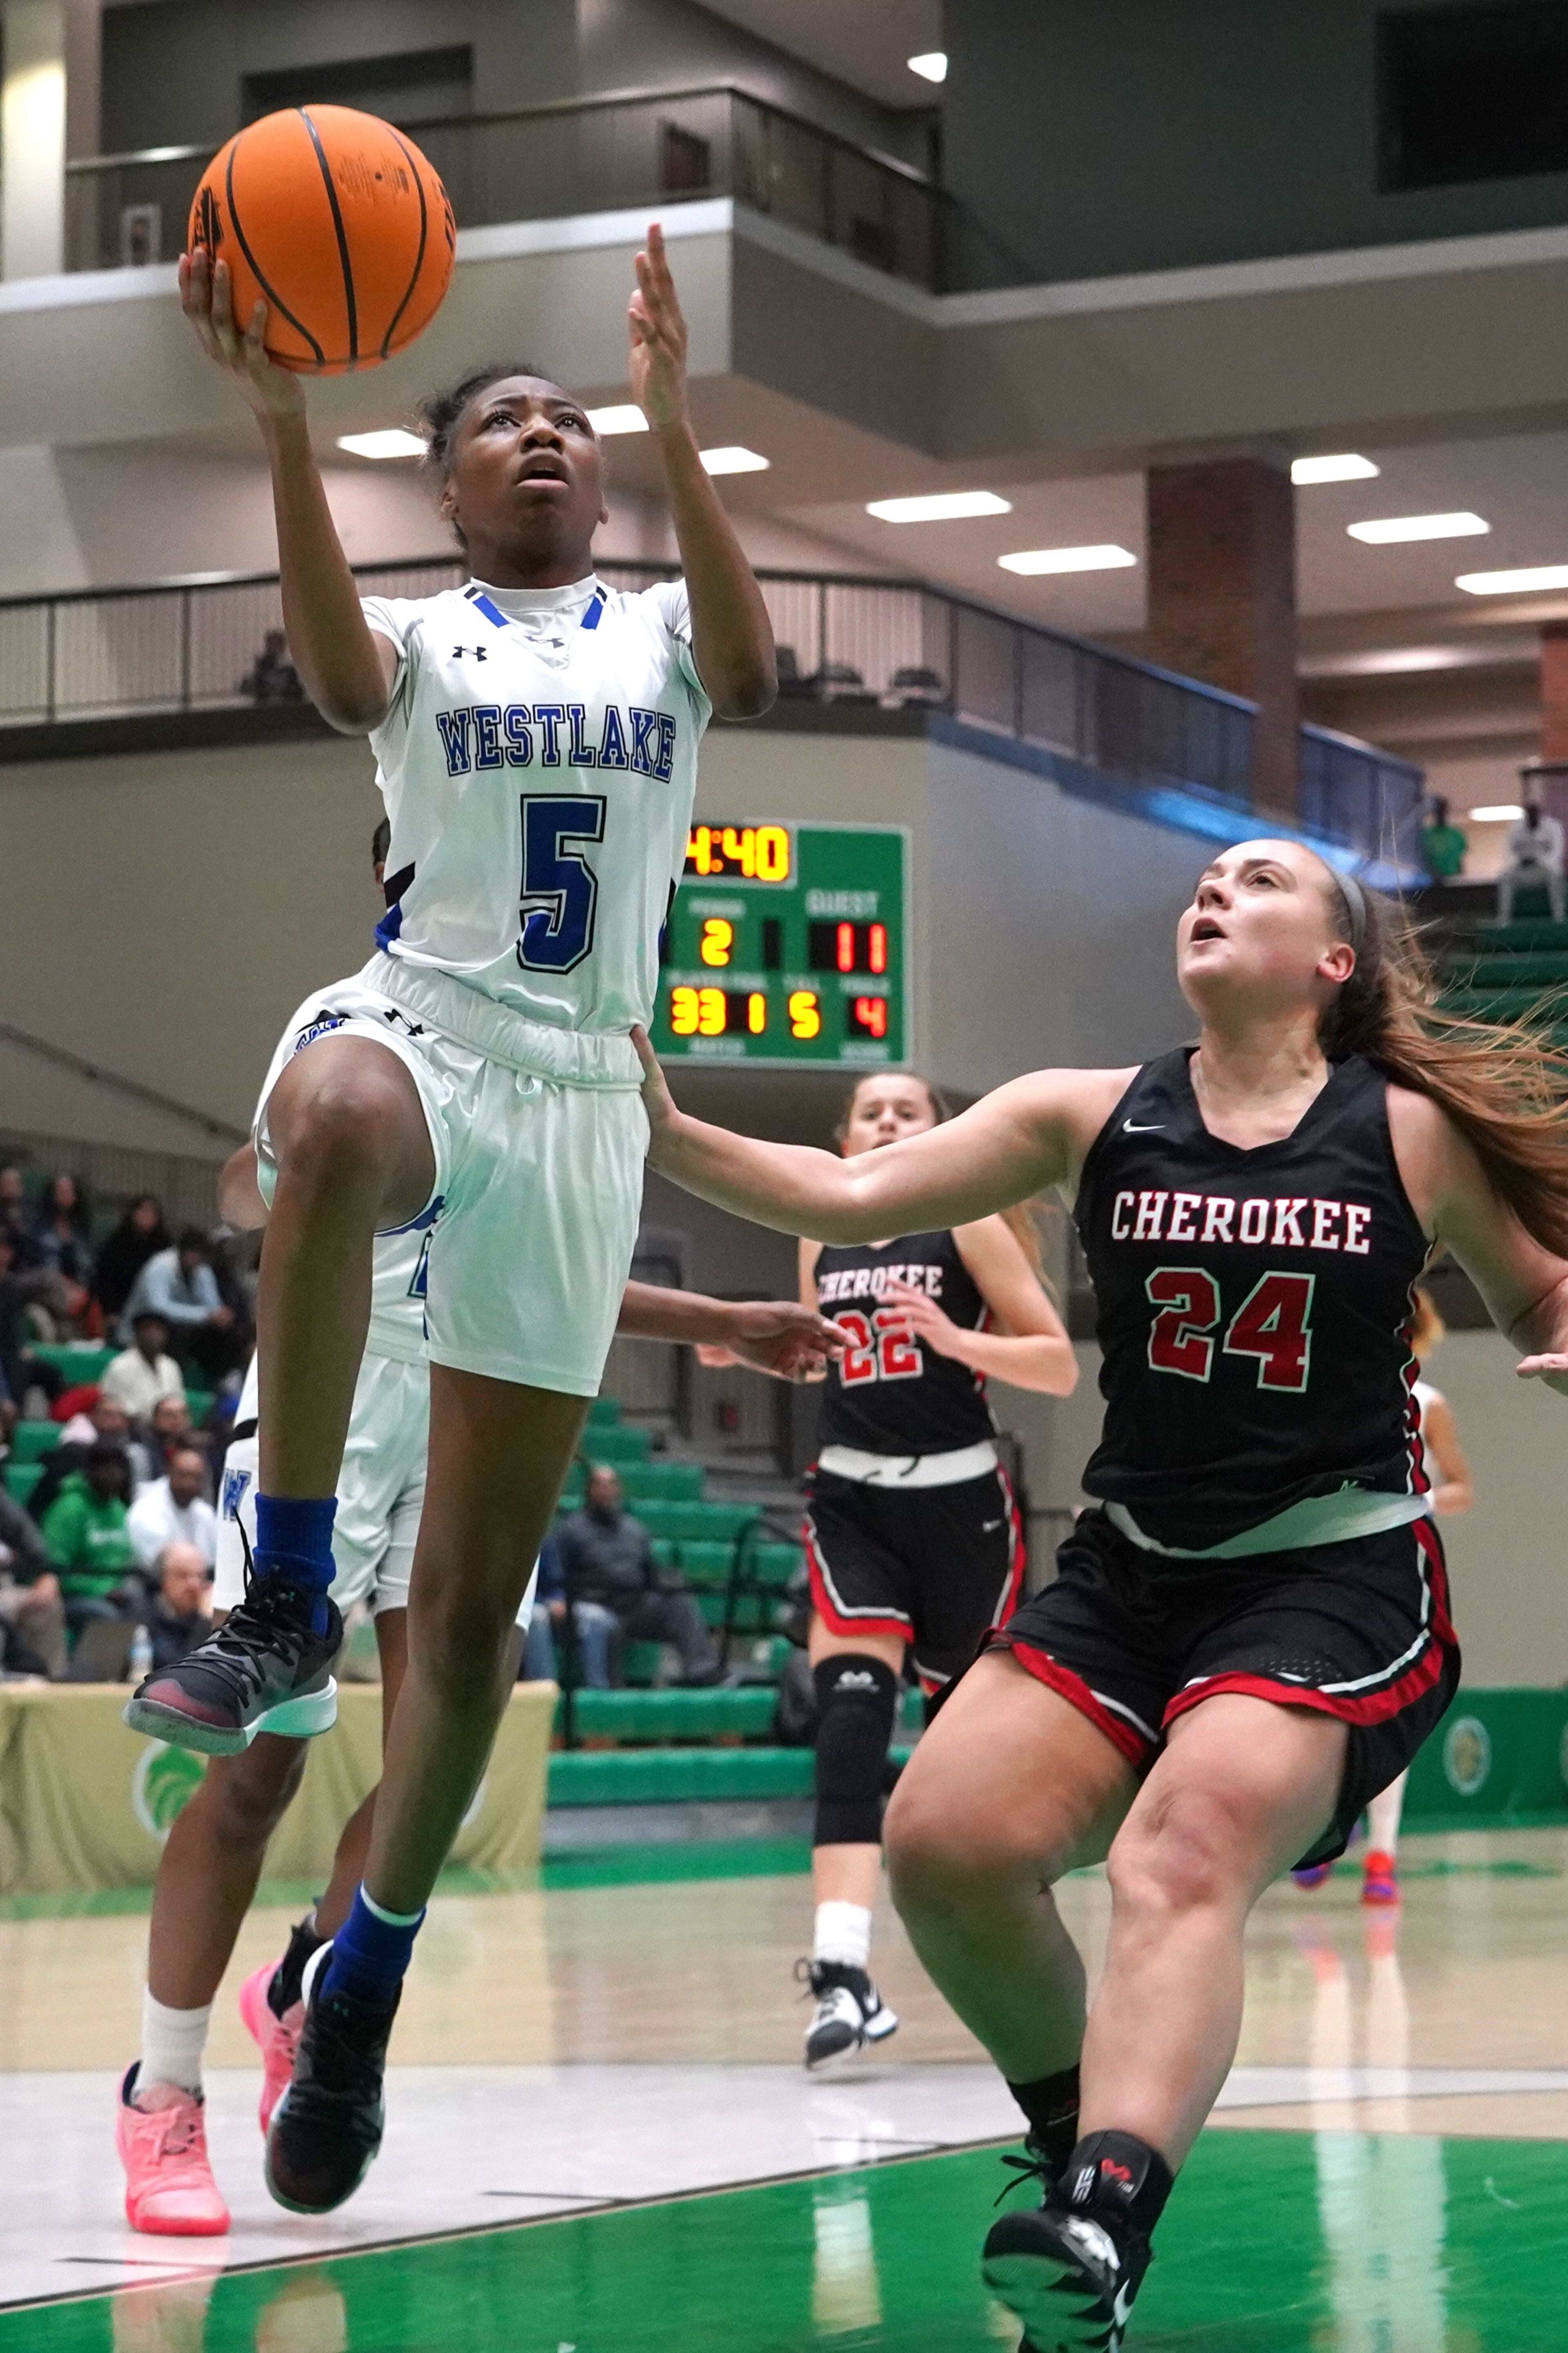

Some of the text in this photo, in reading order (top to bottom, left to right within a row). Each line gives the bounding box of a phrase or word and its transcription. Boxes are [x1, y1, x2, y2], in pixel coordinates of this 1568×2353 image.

[436, 704, 675, 783] WESTLAKE
[516, 794, 607, 975] 5
[701, 918, 733, 966] 2
[837, 921, 886, 974] 11
[671, 986, 765, 1035] 33 1
[788, 991, 820, 1039] 5
[855, 996, 886, 1037] 4
[1111, 1190, 1372, 1255] CHEROKEE
[833, 1309, 924, 1387] 22
[1145, 1266, 1316, 1393] 24
